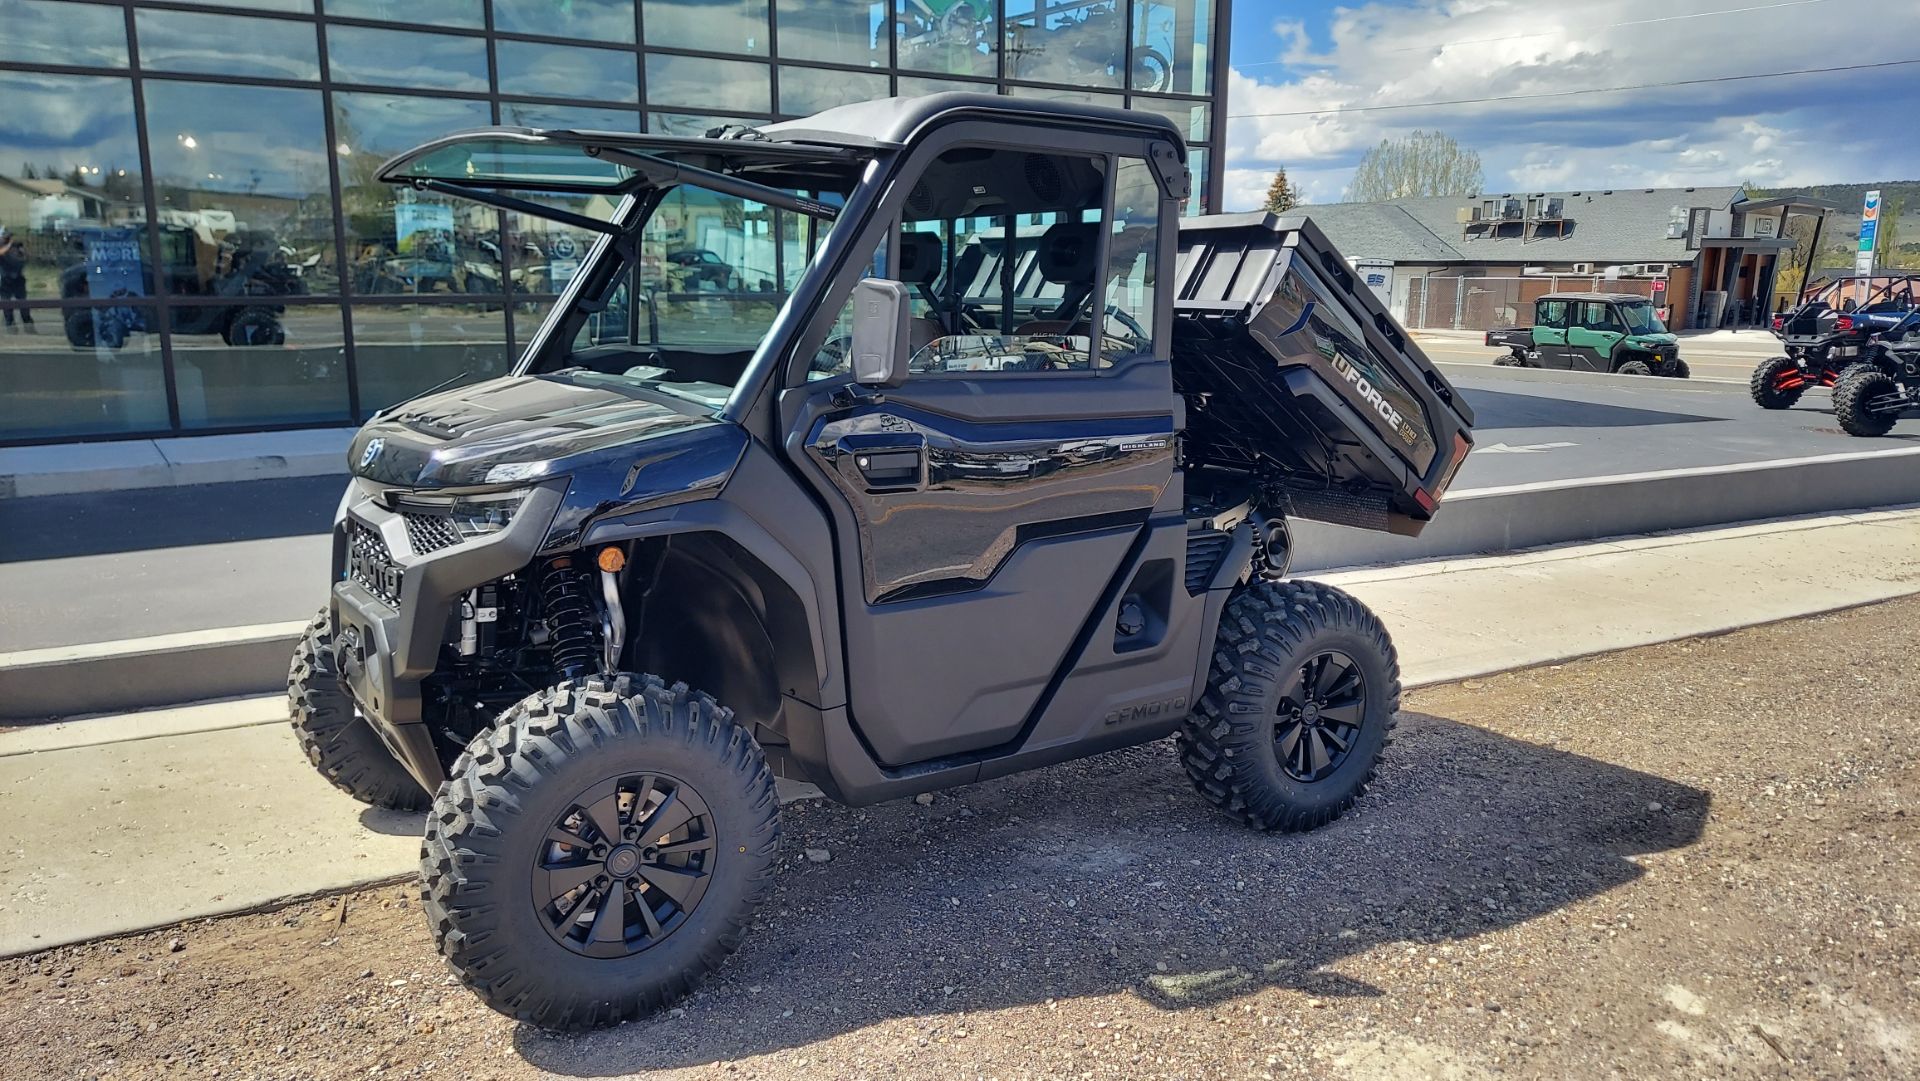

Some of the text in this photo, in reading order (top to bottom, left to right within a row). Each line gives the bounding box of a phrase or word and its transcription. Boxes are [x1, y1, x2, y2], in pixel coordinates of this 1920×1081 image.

[1331, 352, 1403, 432] UFORCE
[1122, 441, 1165, 449] HIGHLAND
[1104, 696, 1186, 725] CFMOTO
